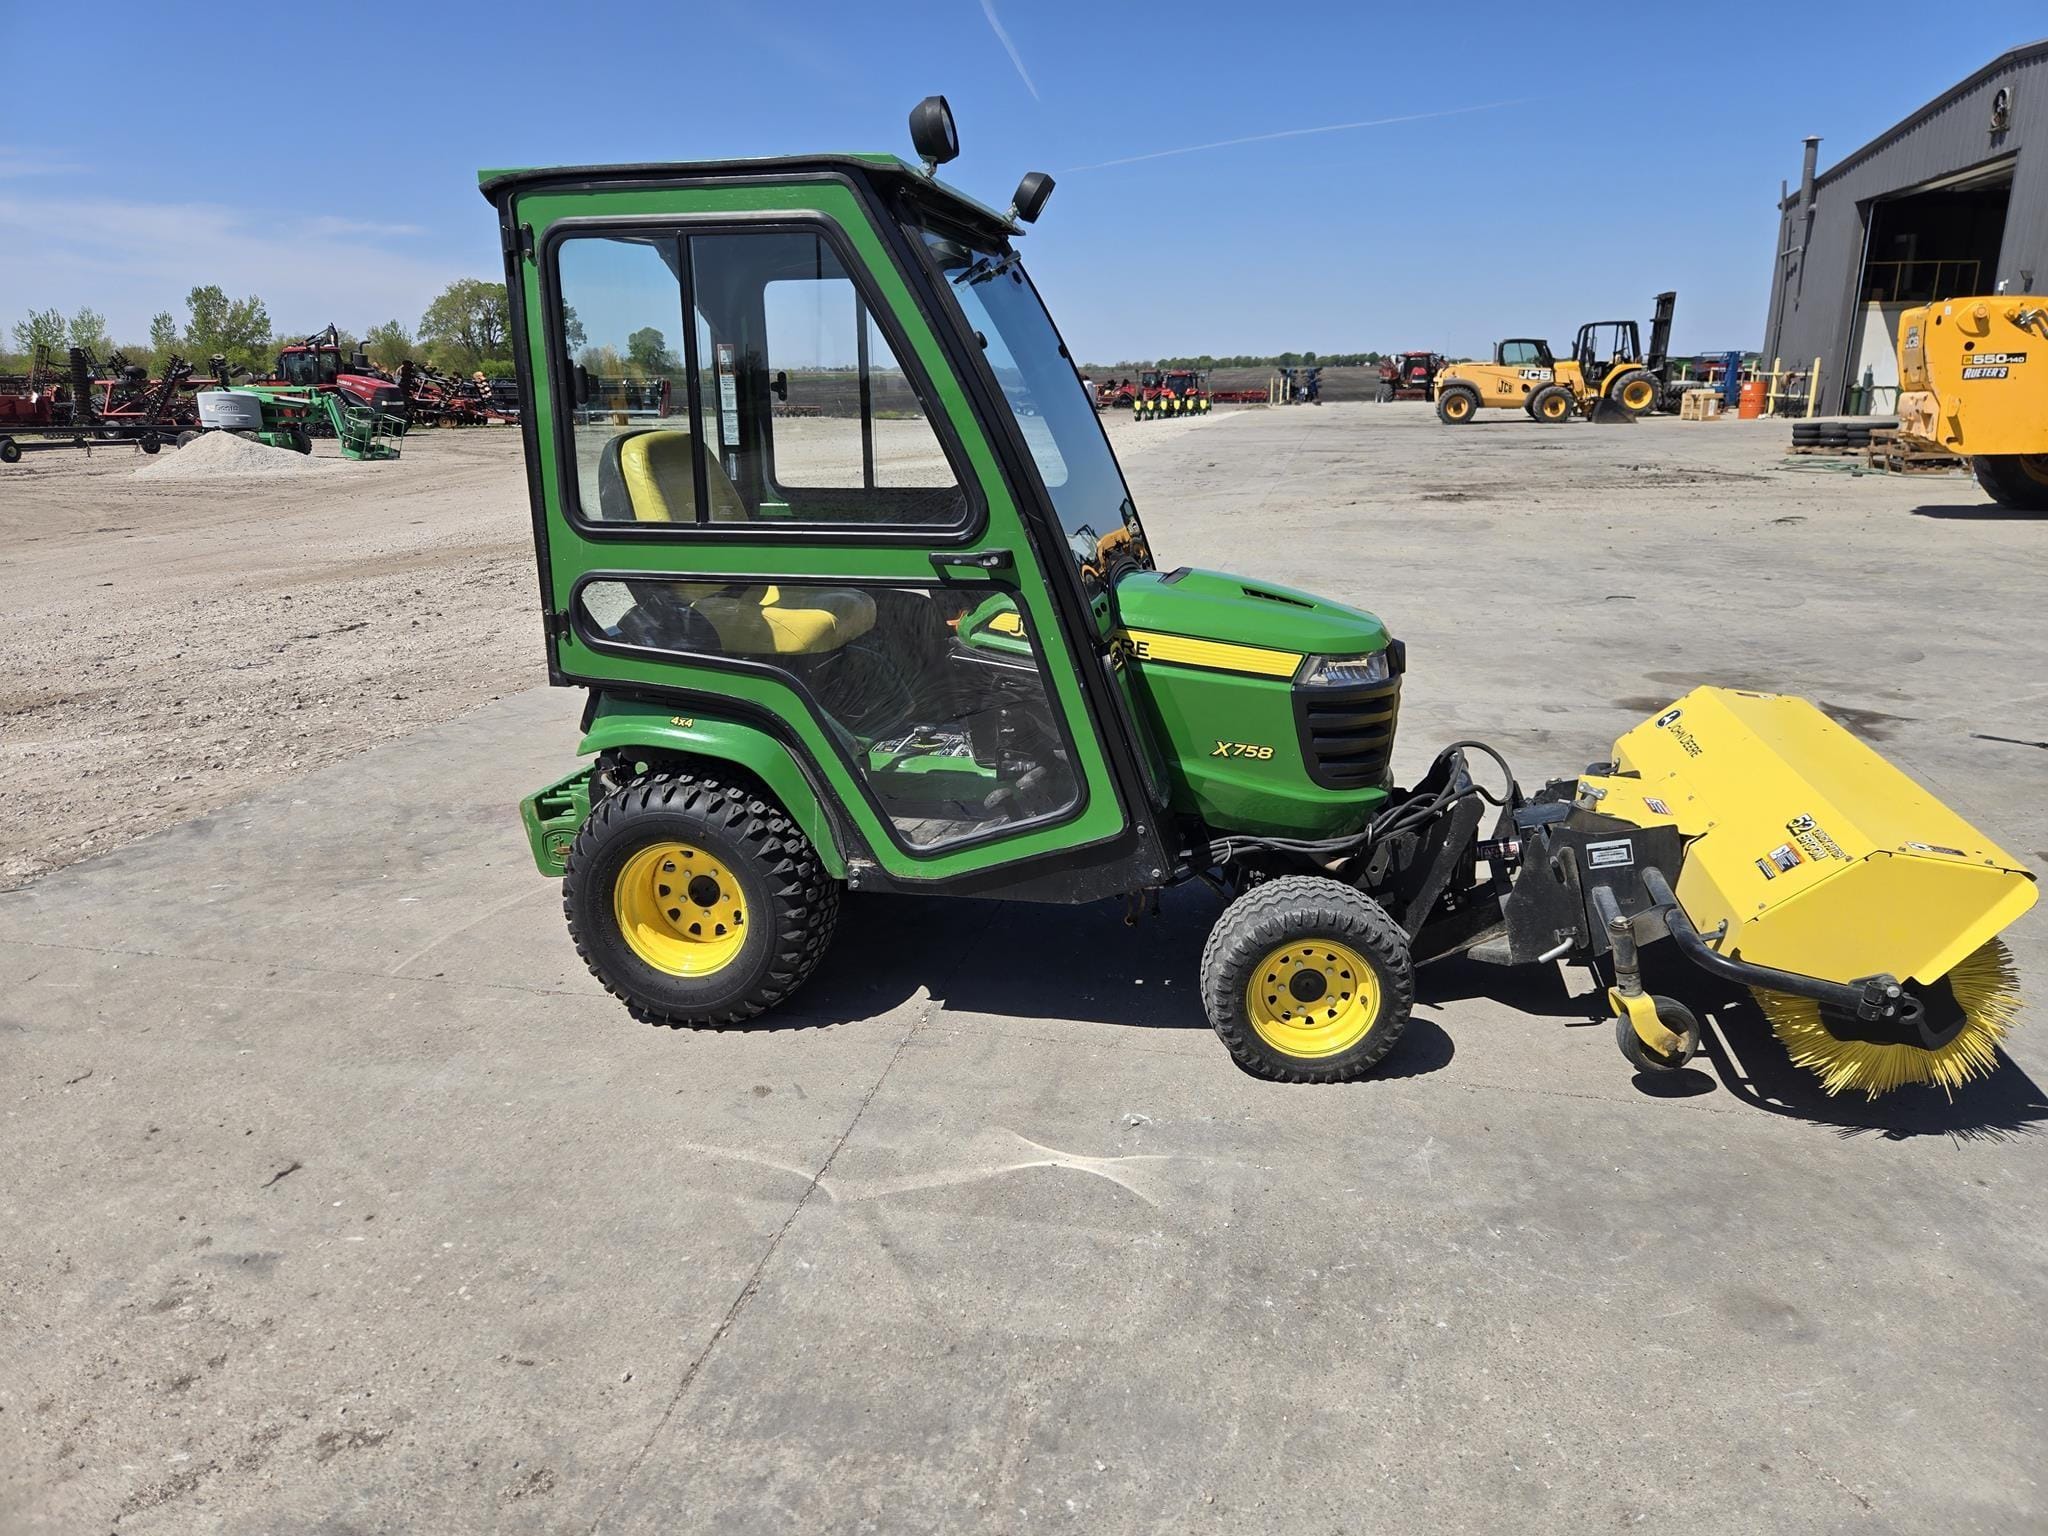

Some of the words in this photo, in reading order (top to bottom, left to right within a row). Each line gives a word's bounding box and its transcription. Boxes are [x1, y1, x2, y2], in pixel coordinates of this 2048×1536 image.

[1519, 369, 1551, 380] JCB
[1963, 367, 2008, 379] RUETER'S
[1498, 380, 1512, 394] JCB
[670, 716, 694, 728] 4x4
[1210, 740, 1275, 760] X758
[1679, 734, 1703, 758] DEERE
[1786, 813, 1816, 837] 52
[1796, 832, 1829, 862] BROOM
